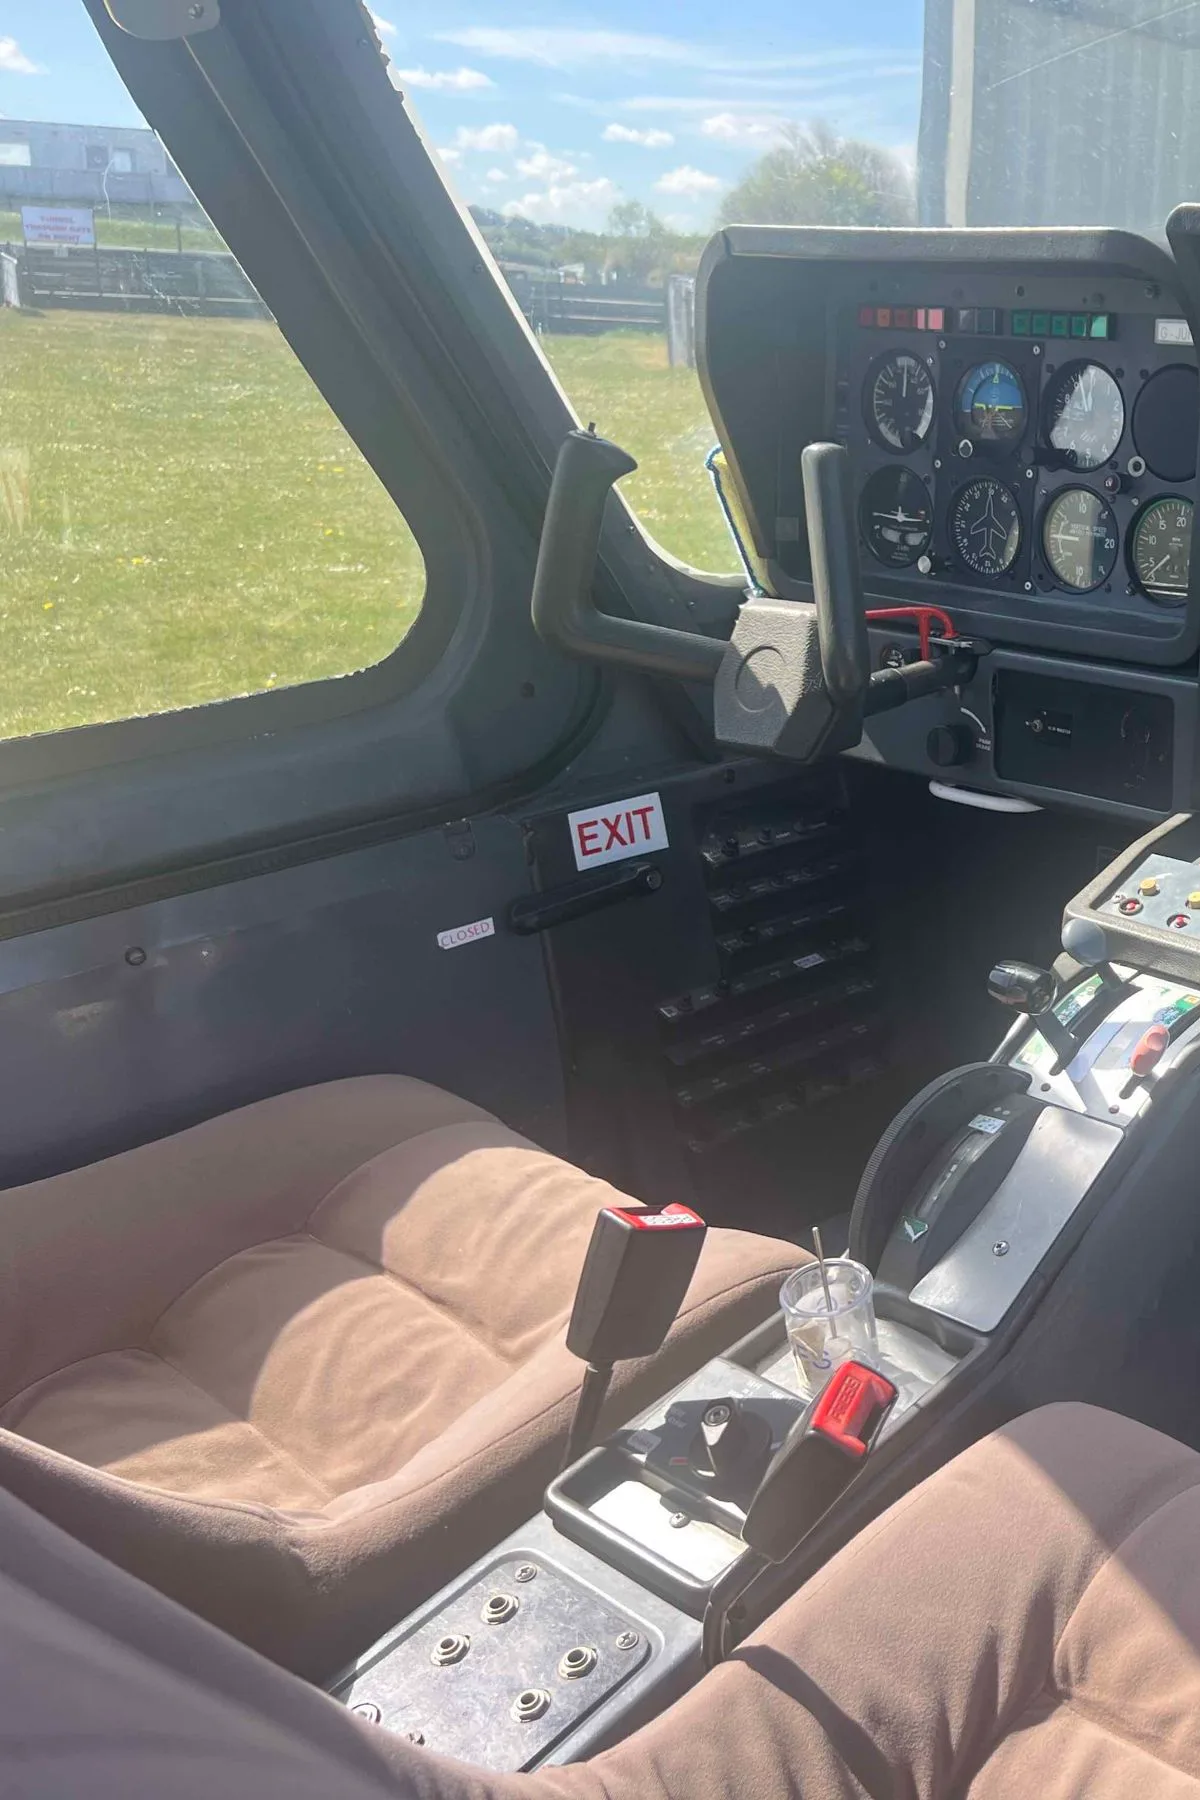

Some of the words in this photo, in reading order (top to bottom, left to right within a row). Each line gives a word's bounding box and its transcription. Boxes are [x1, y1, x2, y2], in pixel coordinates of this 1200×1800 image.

[1079, 503, 1087, 514] 10
[1159, 519, 1167, 530] 15
[1176, 516, 1187, 527] 20
[1104, 538, 1115, 549] 20
[1148, 535, 1157, 545] 10
[1075, 565, 1084, 576] 10
[577, 806, 654, 857] EXIT
[441, 921, 490, 947] CLOSED
[827, 1375, 861, 1421] PRESS
